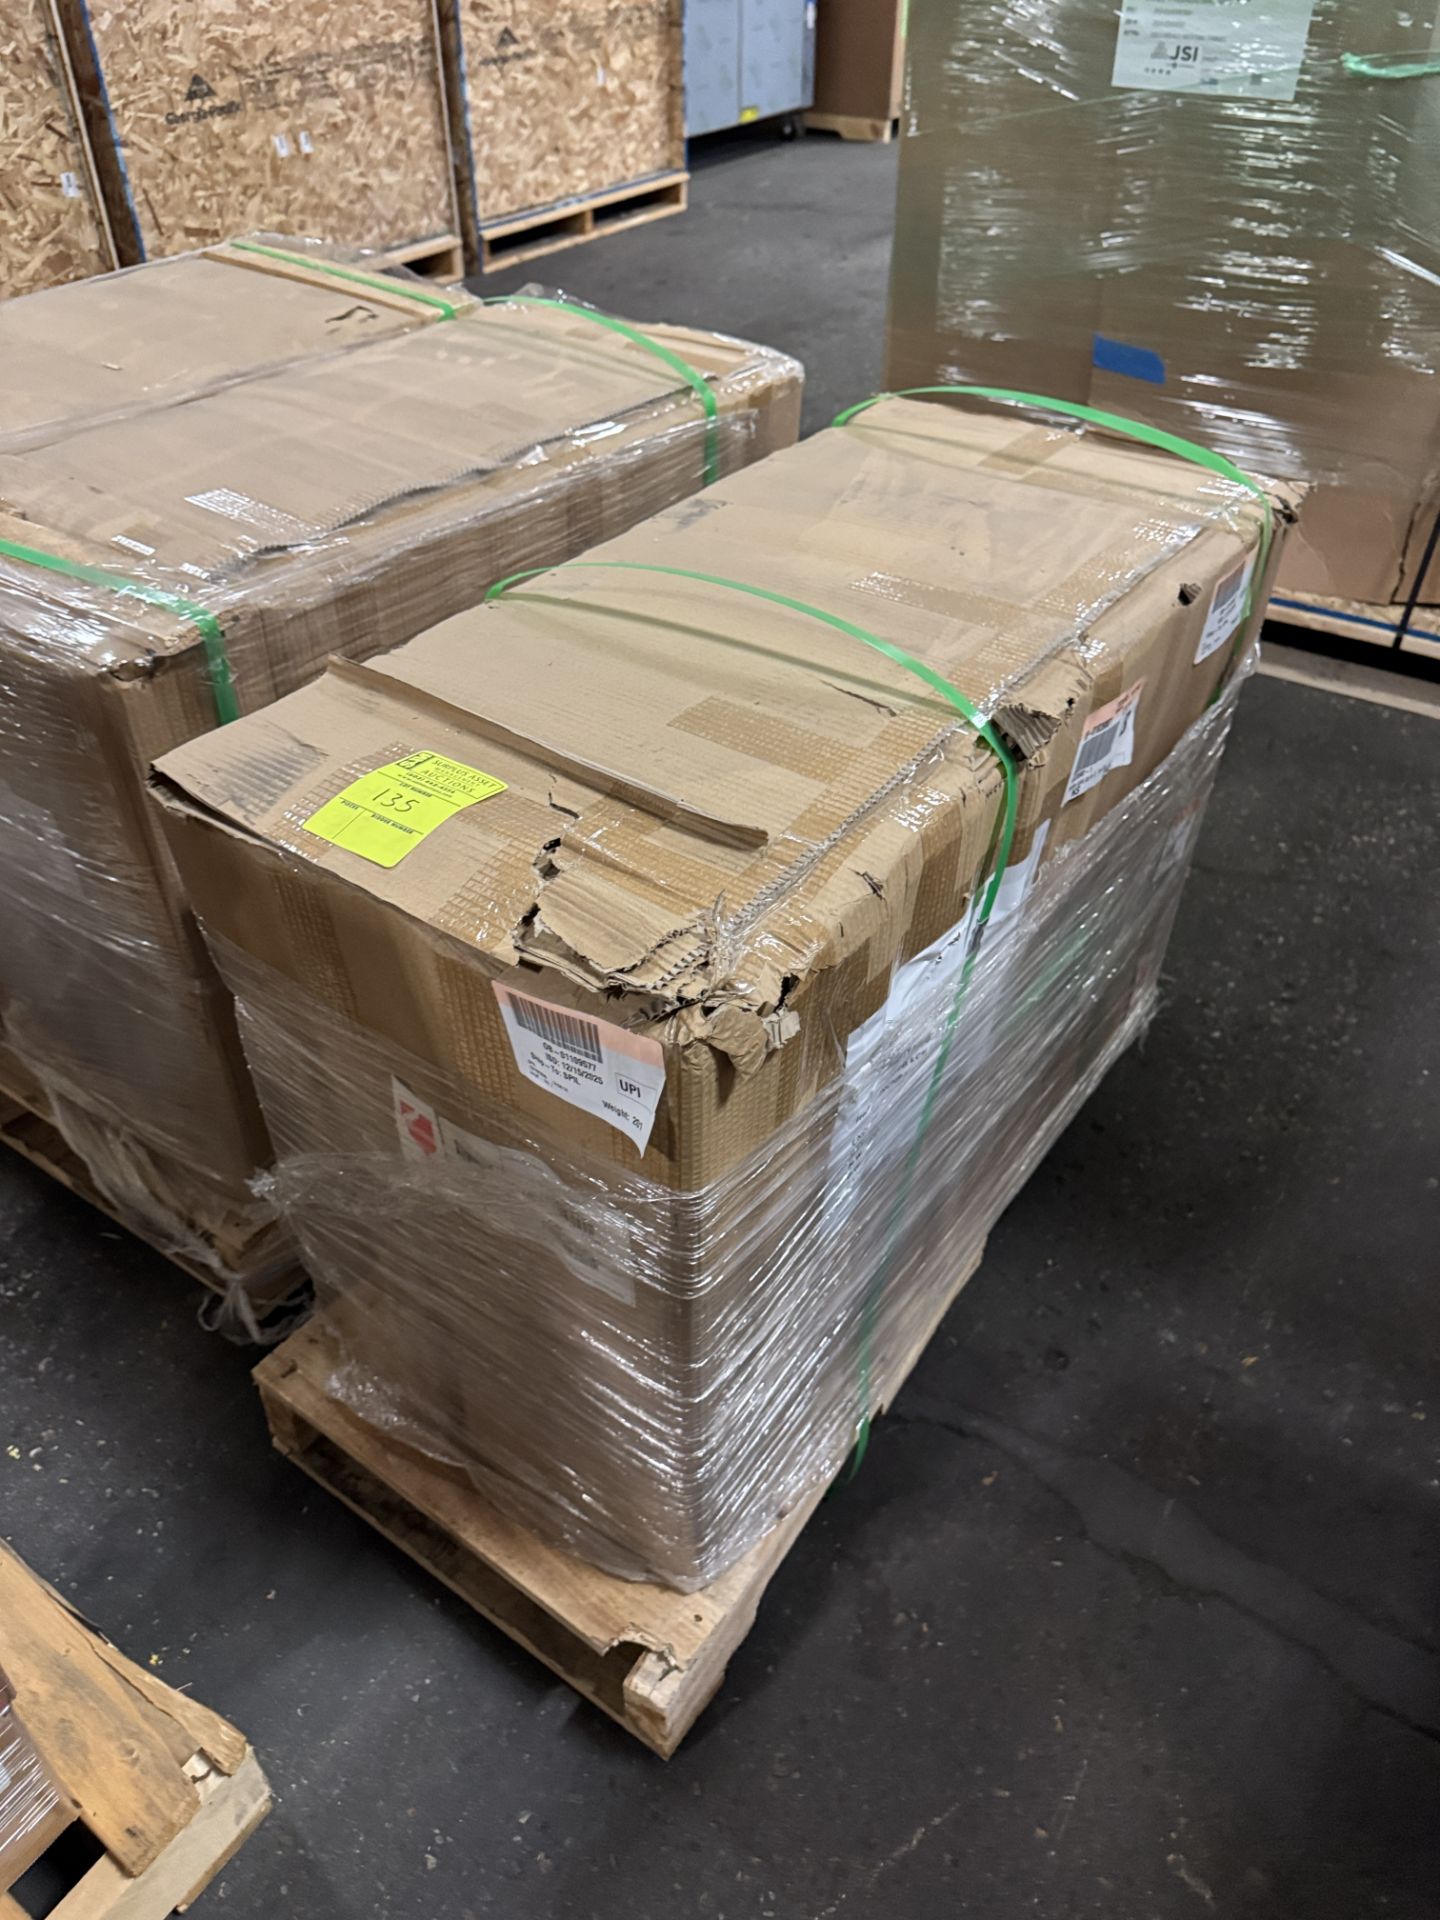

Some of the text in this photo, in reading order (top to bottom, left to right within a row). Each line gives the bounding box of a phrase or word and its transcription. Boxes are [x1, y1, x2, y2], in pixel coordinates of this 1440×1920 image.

[1169, 45, 1199, 62] JSI
[421, 770, 475, 793] AUCTIONS
[432, 759, 468, 776] SURPLUS
[470, 774, 498, 788] ASSET
[372, 788, 420, 813] 135
[619, 1079, 641, 1098] UPI
[602, 1099, 631, 1121] Weight:
